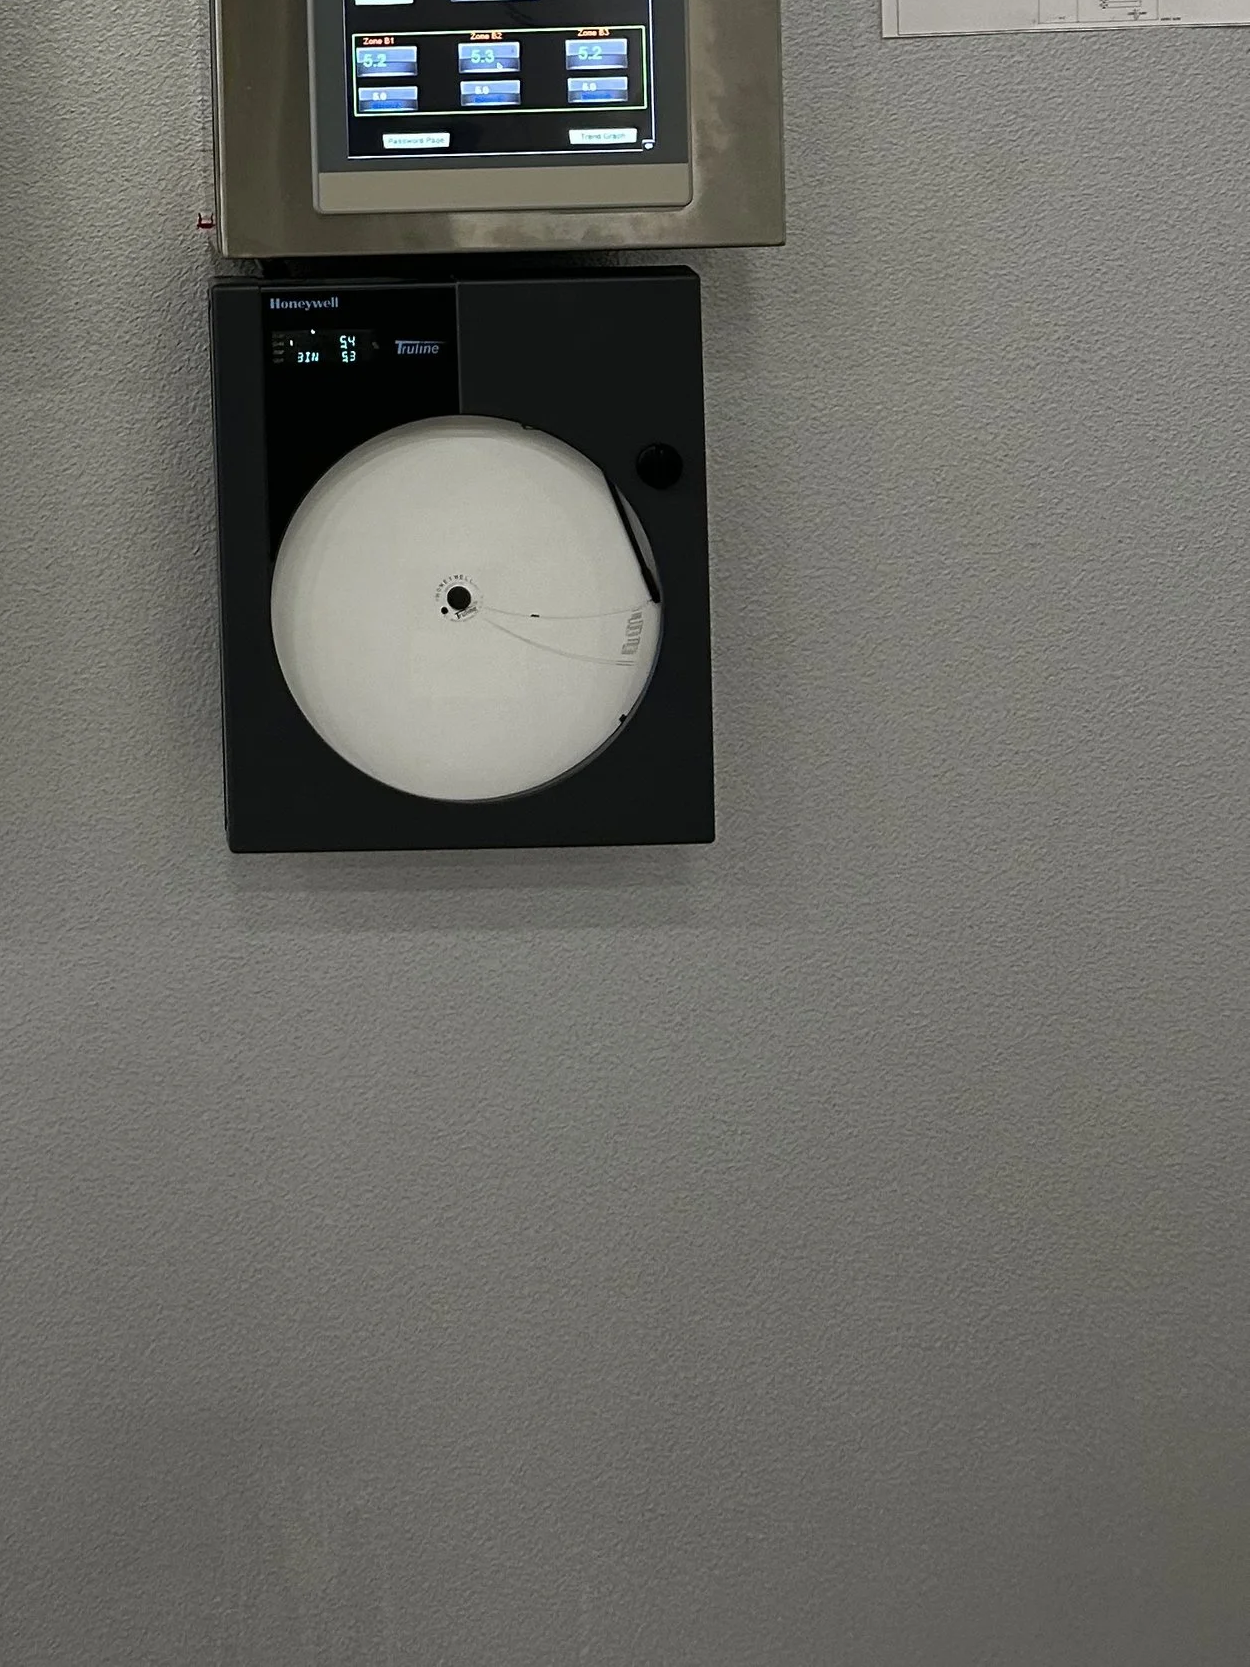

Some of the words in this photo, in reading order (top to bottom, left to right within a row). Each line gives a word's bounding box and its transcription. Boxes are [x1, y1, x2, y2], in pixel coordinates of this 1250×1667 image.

[362, 37, 383, 45] Zone
[384, 36, 395, 45] B1
[470, 32, 490, 40] Zone
[470, 49, 495, 64] 5.3
[578, 45, 603, 60] 5.2
[362, 53, 387, 68] 5.2
[269, 296, 339, 311] Honeywell
[340, 335, 356, 349] 54
[395, 340, 447, 355] Truline
[341, 350, 356, 363] 53
